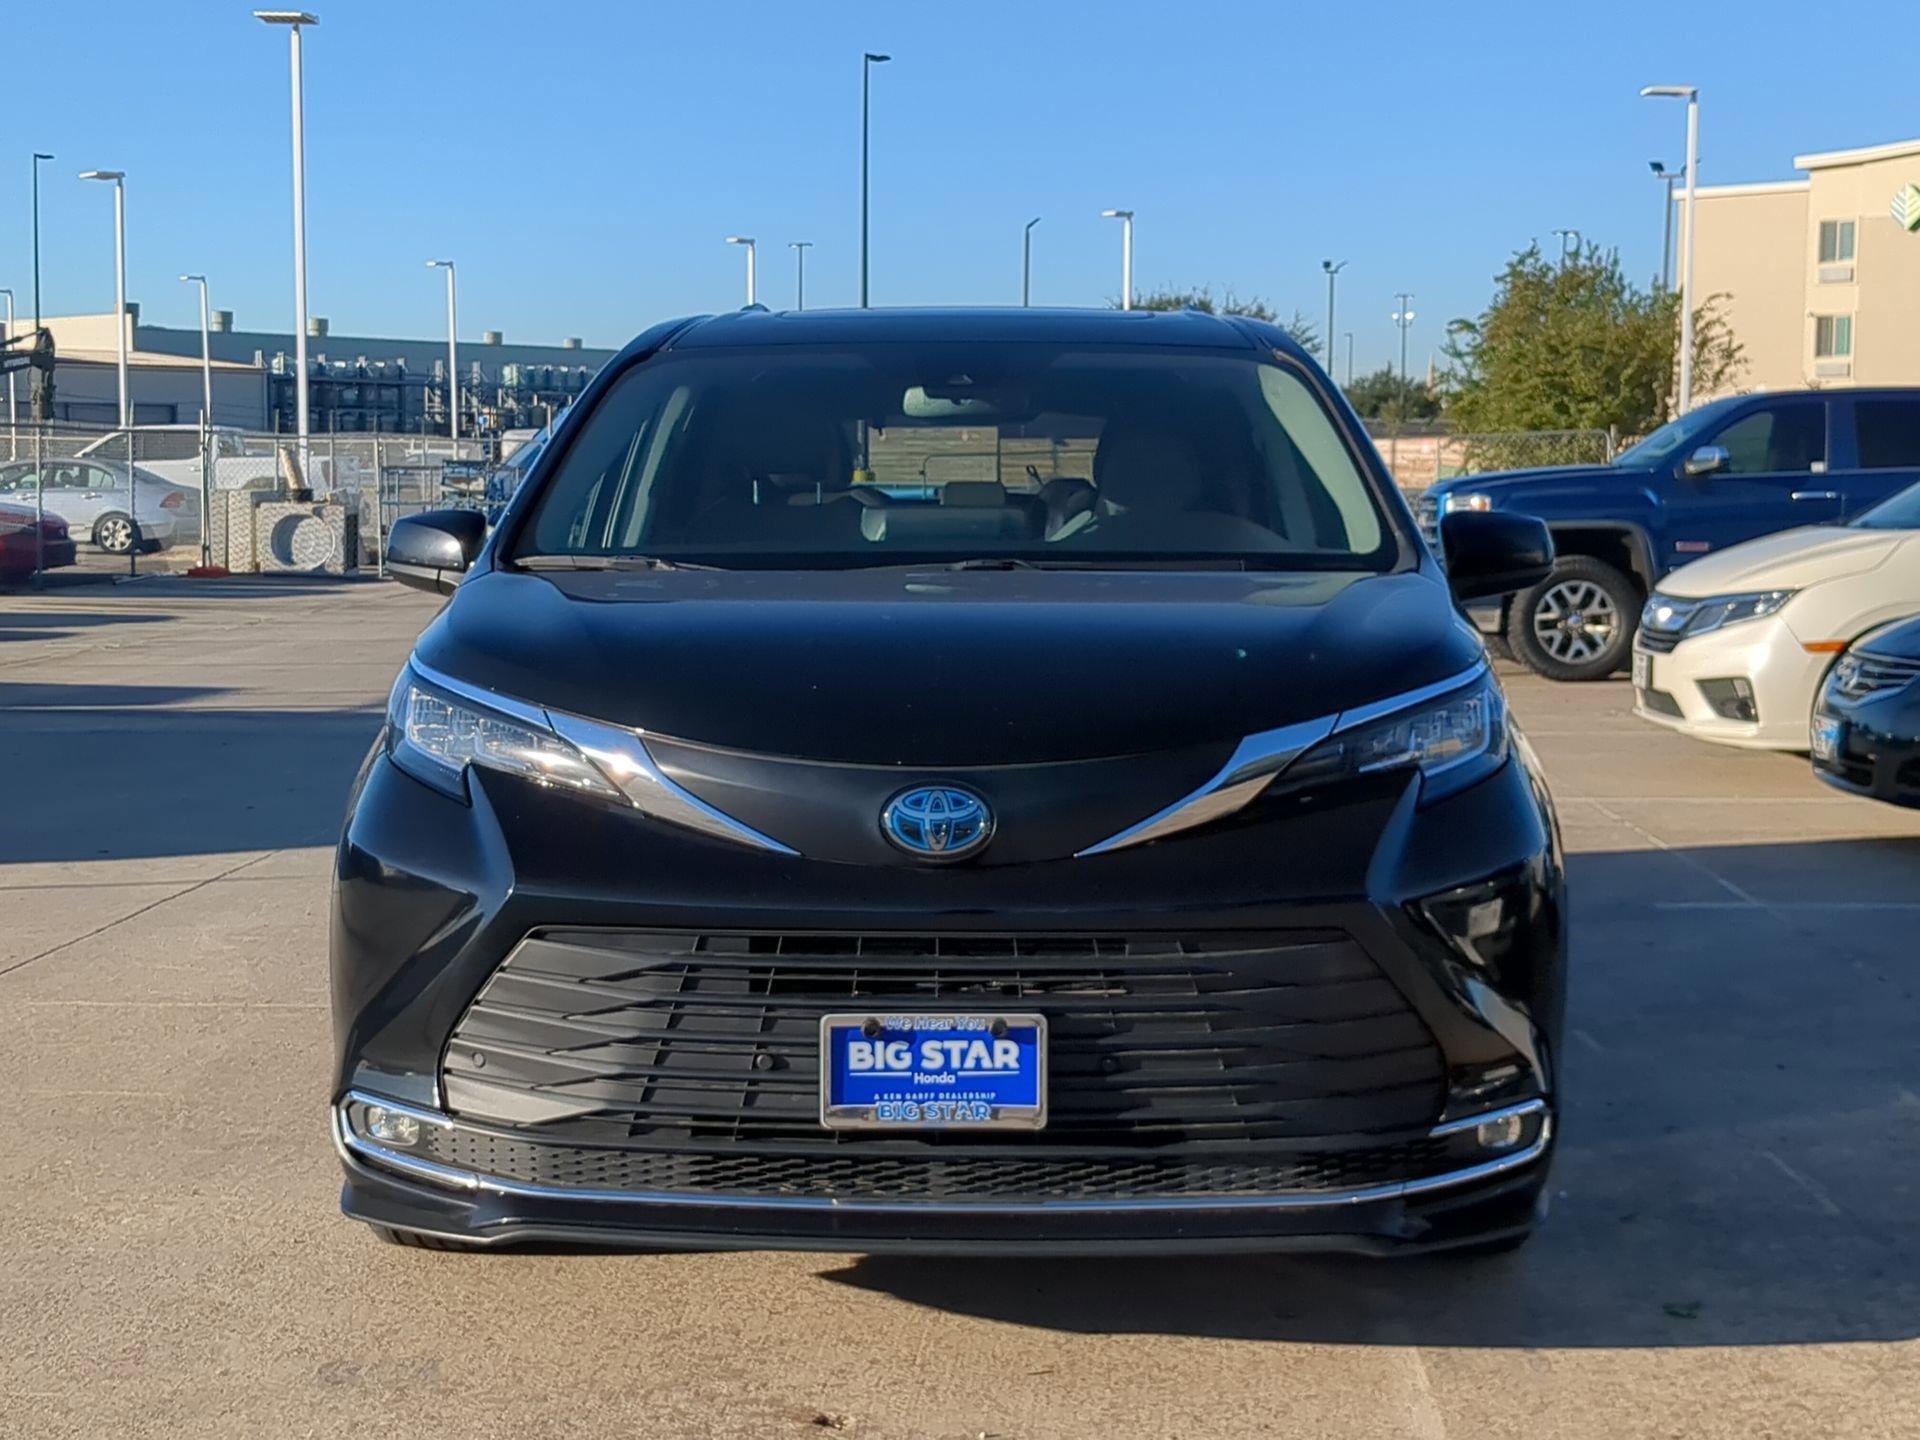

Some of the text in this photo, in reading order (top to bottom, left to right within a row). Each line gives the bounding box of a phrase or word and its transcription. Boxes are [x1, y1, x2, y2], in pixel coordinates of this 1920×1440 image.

[885, 1015, 986, 1031] We Hear You
[848, 1040, 1020, 1070] BIG STAR
[913, 1072, 956, 1084] Honda
[877, 1101, 992, 1120] BIG STAR
